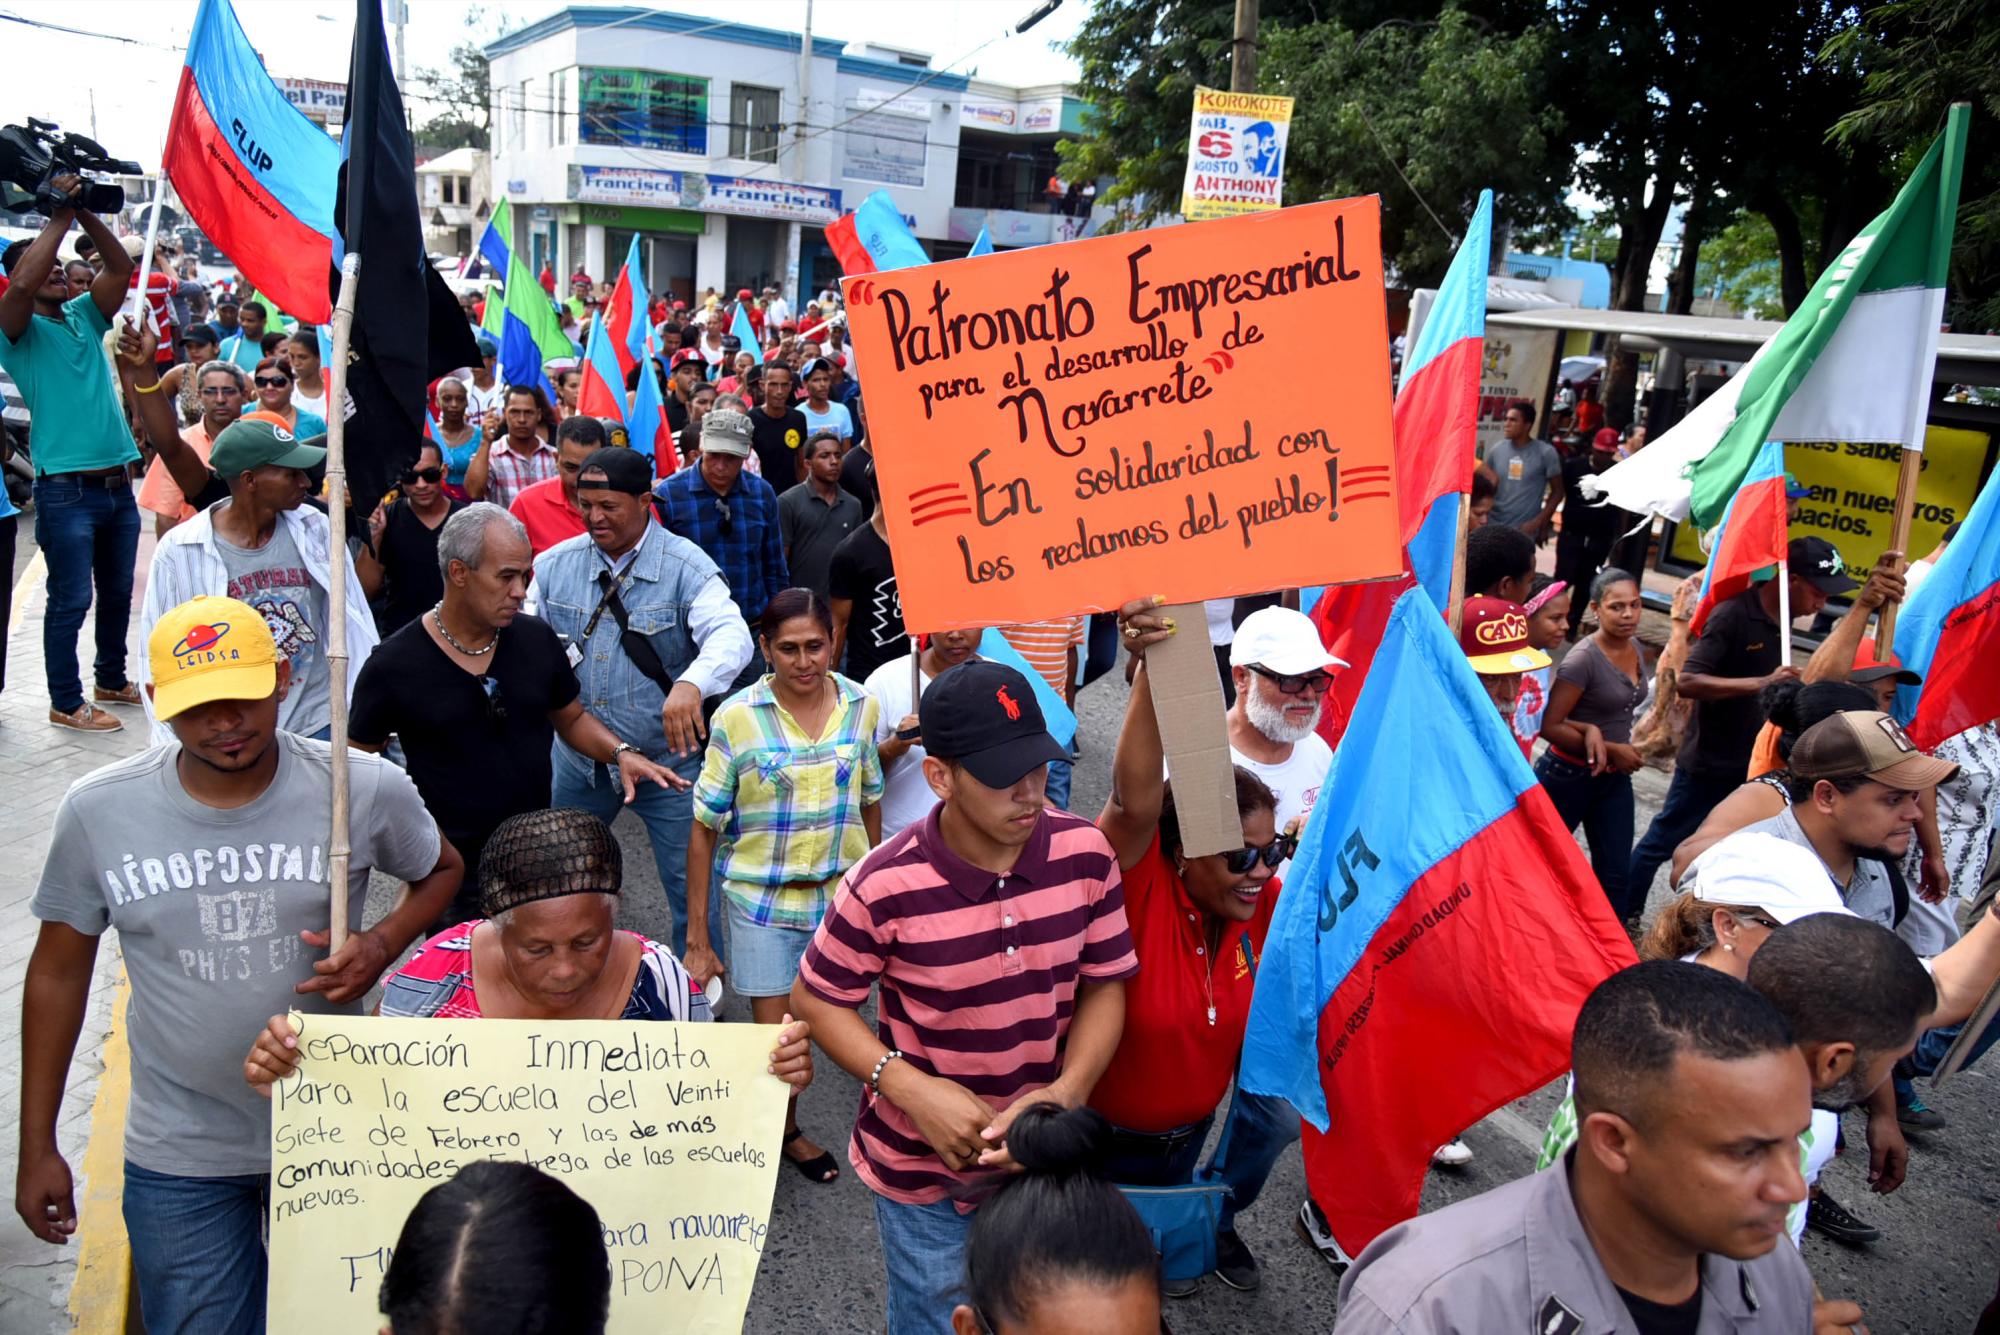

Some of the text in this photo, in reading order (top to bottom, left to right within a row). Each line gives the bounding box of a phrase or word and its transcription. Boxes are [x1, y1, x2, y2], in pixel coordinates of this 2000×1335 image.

[1200, 92, 1288, 113] KOROKOTE
[232, 117, 273, 173] FLUP
[1197, 131, 1233, 159] 6
[585, 175, 676, 193] Francisco
[1194, 160, 1239, 175] AGOSTO
[1194, 174, 1278, 195] ANTHONY
[711, 184, 836, 209] Francisco
[1194, 193, 1277, 206] SANTOS
[1127, 215, 1361, 340] Empresarial
[918, 310, 1265, 421] para el desarrollo de
[969, 419, 1341, 527] En solidaridad con
[956, 455, 1339, 585] los reclamos del pueblo!
[1843, 489, 1955, 524] nuesros
[1478, 616, 1527, 642] CAVS
[178, 648, 240, 671] LEIDSA
[105, 843, 331, 906] AÉROPOSTAL
[526, 1027, 711, 1073] Inmediata
[382, 1077, 409, 1112] la
[443, 1082, 559, 1114] escuela
[587, 1078, 638, 1114] del
[368, 1113, 408, 1147] de
[426, 1125, 520, 1151] Febrero
[582, 1122, 619, 1143] las
[629, 1119, 659, 1140] de
[665, 1115, 717, 1134] más
[604, 1147, 633, 1169] de
[644, 1145, 675, 1166] las
[686, 1142, 766, 1168] escuelas
[276, 1187, 366, 1223] nuevas.
